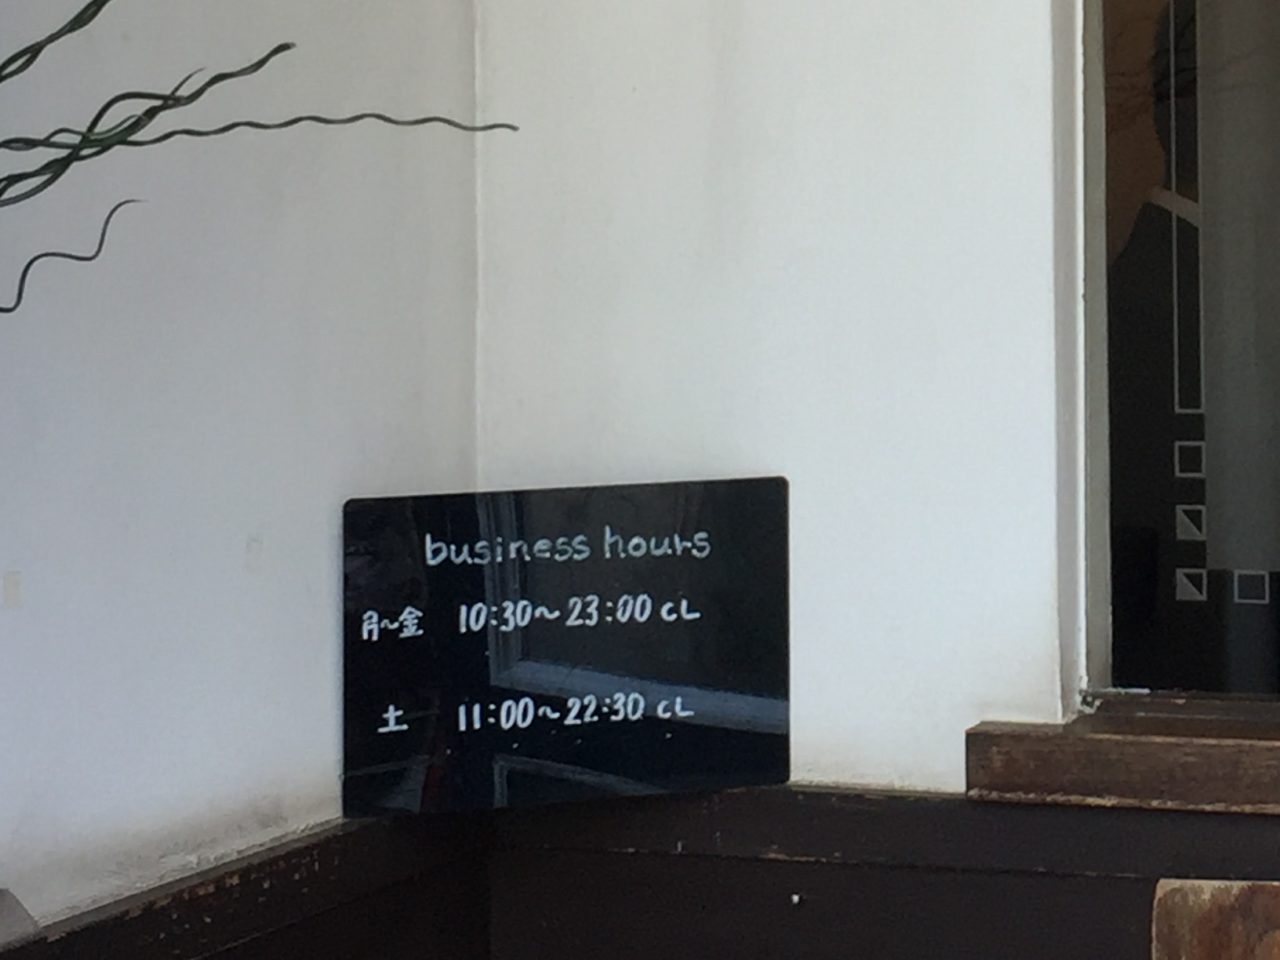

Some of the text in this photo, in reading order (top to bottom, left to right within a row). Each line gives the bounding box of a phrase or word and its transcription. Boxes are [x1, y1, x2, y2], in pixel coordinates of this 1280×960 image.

[425, 524, 712, 567] business hours
[377, 705, 409, 734] 土
